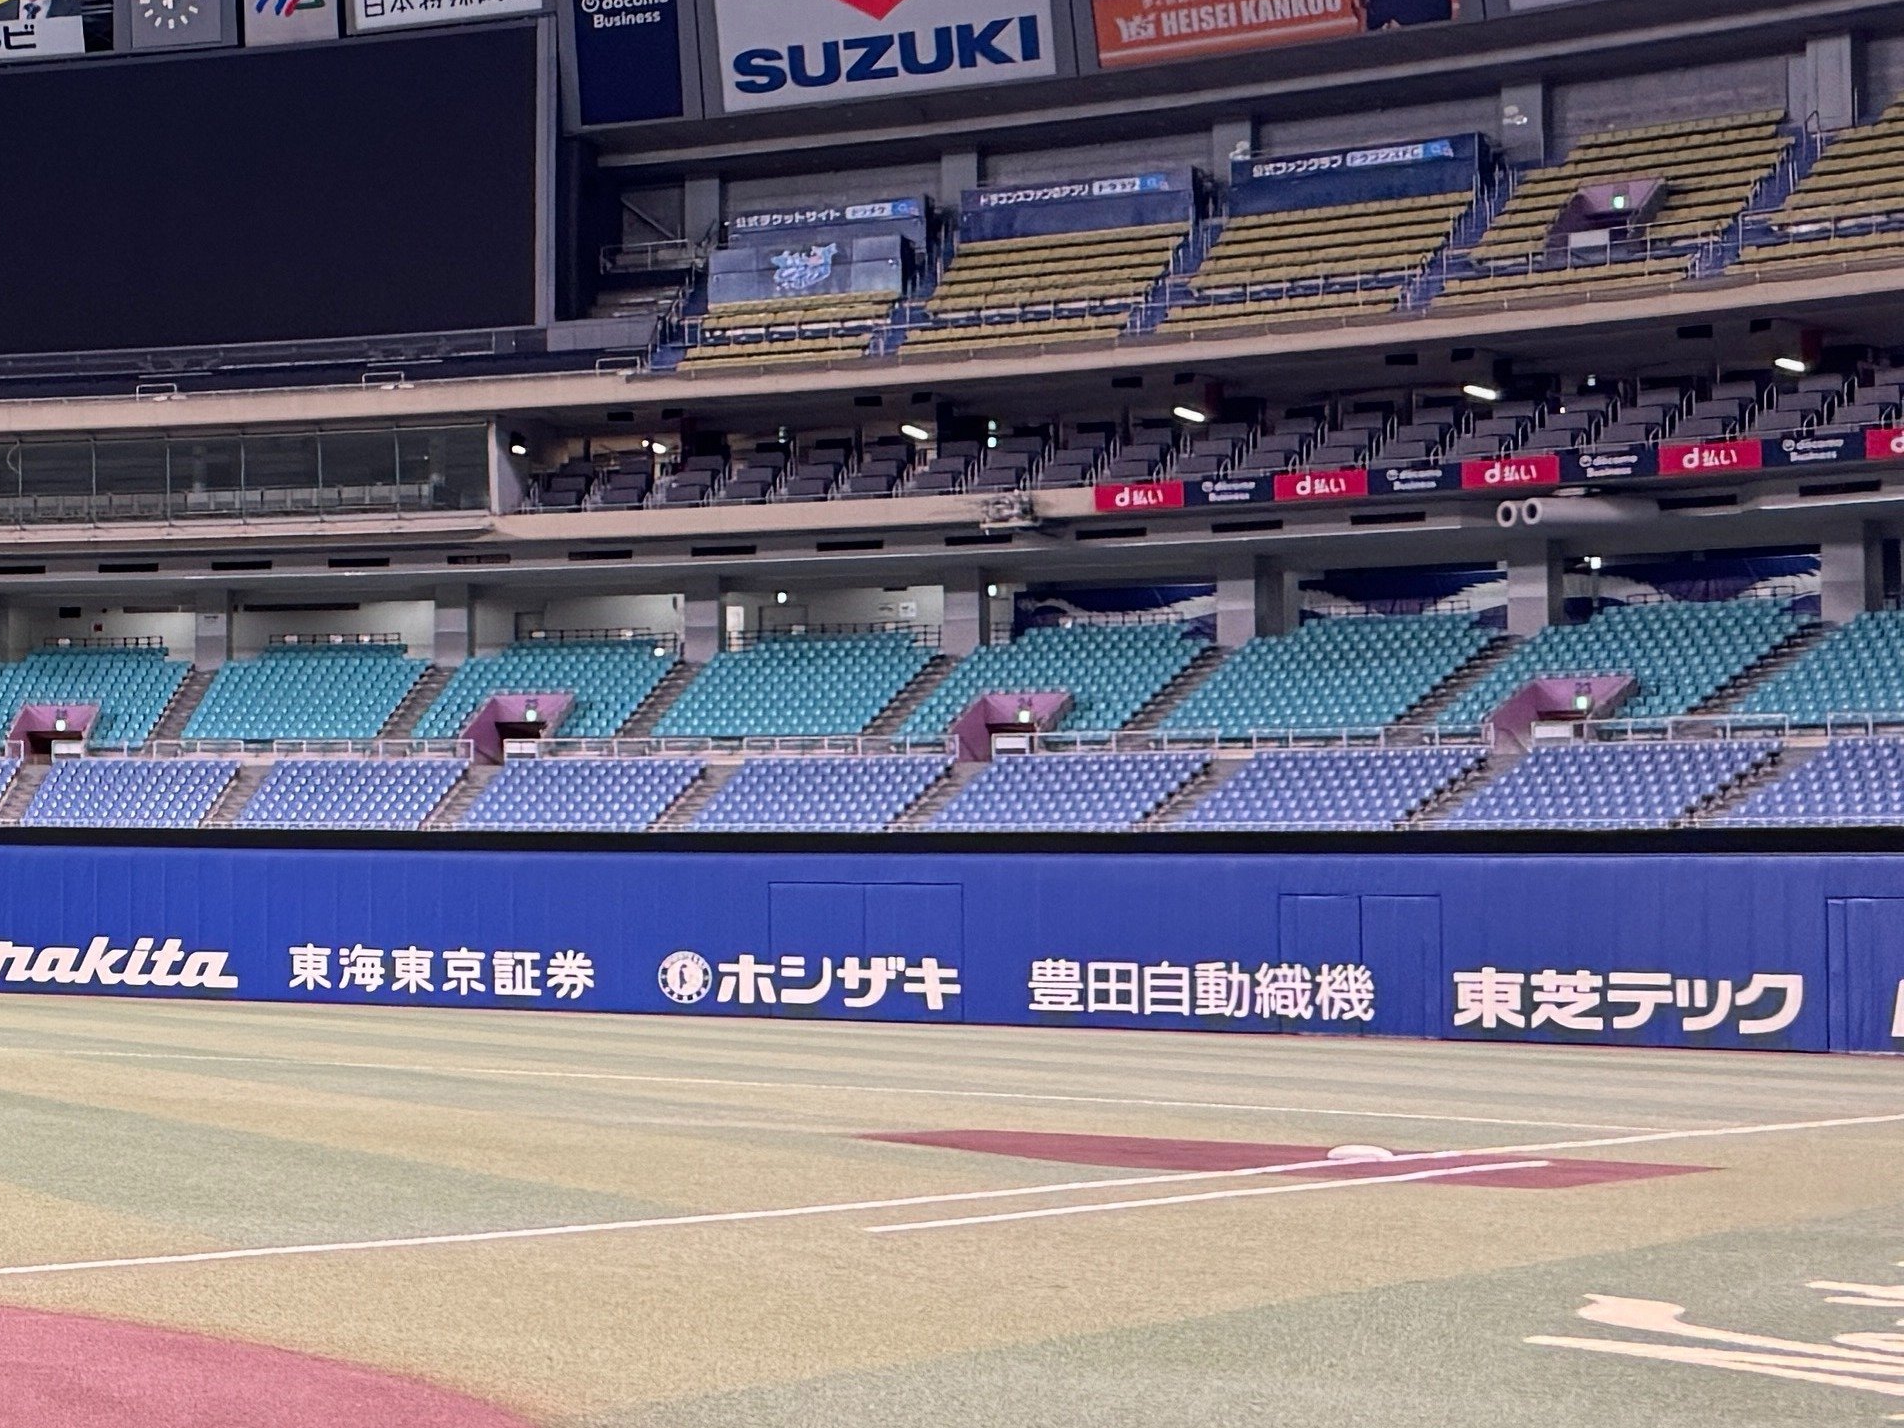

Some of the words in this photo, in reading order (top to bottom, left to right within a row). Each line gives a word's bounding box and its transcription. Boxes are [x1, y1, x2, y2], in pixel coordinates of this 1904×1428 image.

[593, 11, 661, 29] Business
[1160, 2, 1238, 37] HEISEI
[732, 14, 1041, 94] SUZUKI
[288, 942, 595, 1000] 東海東京証券
[716, 953, 962, 1011] ホシザキ
[1027, 958, 1376, 1022] 豊田自動織機
[1452, 966, 1804, 1035] 東芝テック
